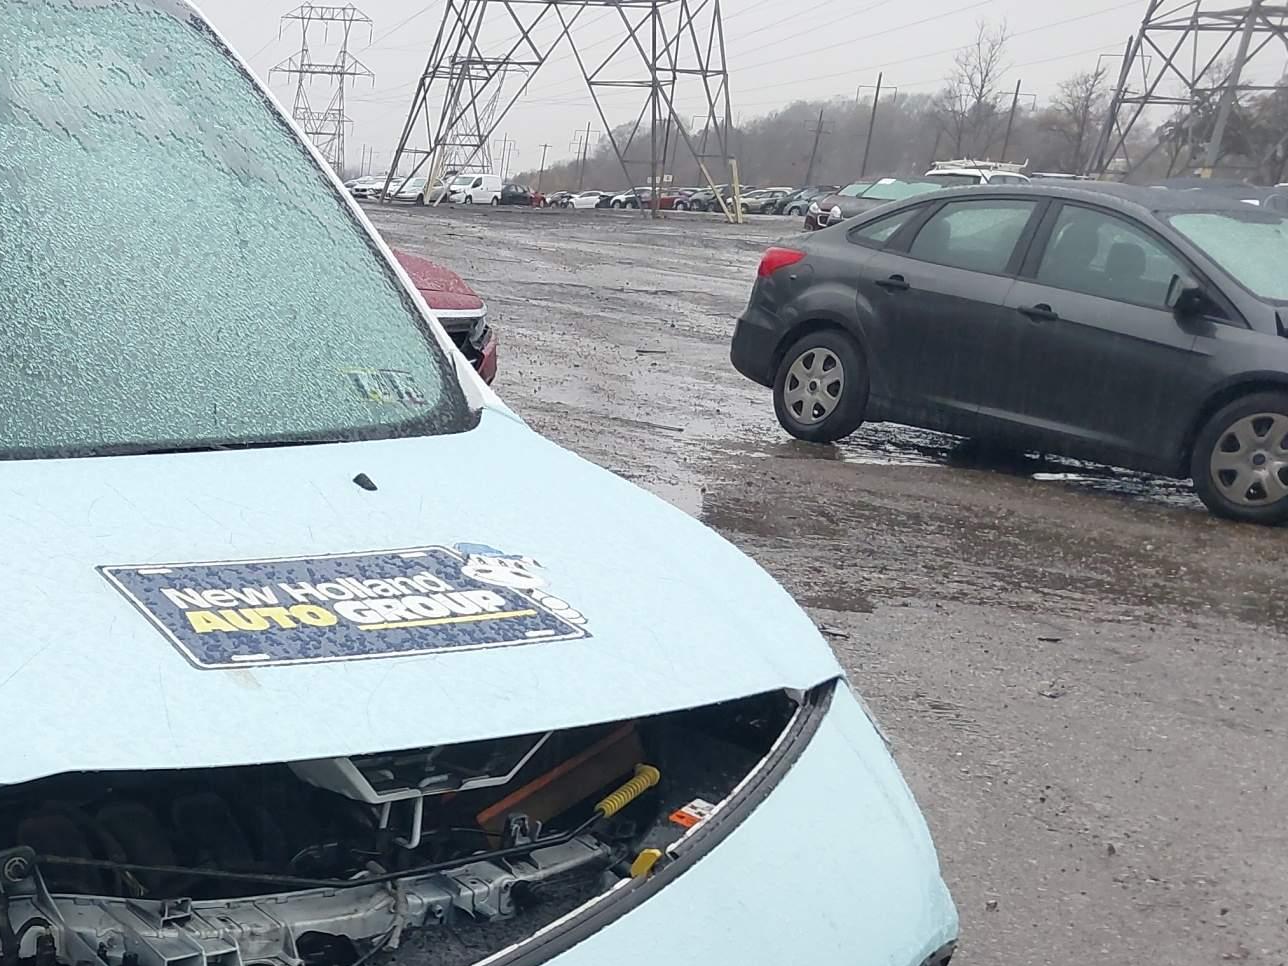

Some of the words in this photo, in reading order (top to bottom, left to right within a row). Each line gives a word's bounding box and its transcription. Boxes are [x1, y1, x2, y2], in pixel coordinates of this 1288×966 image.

[160, 584, 278, 611] New
[281, 571, 455, 604] Holland
[187, 603, 339, 634] AUTO
[332, 589, 508, 626] GROUP
